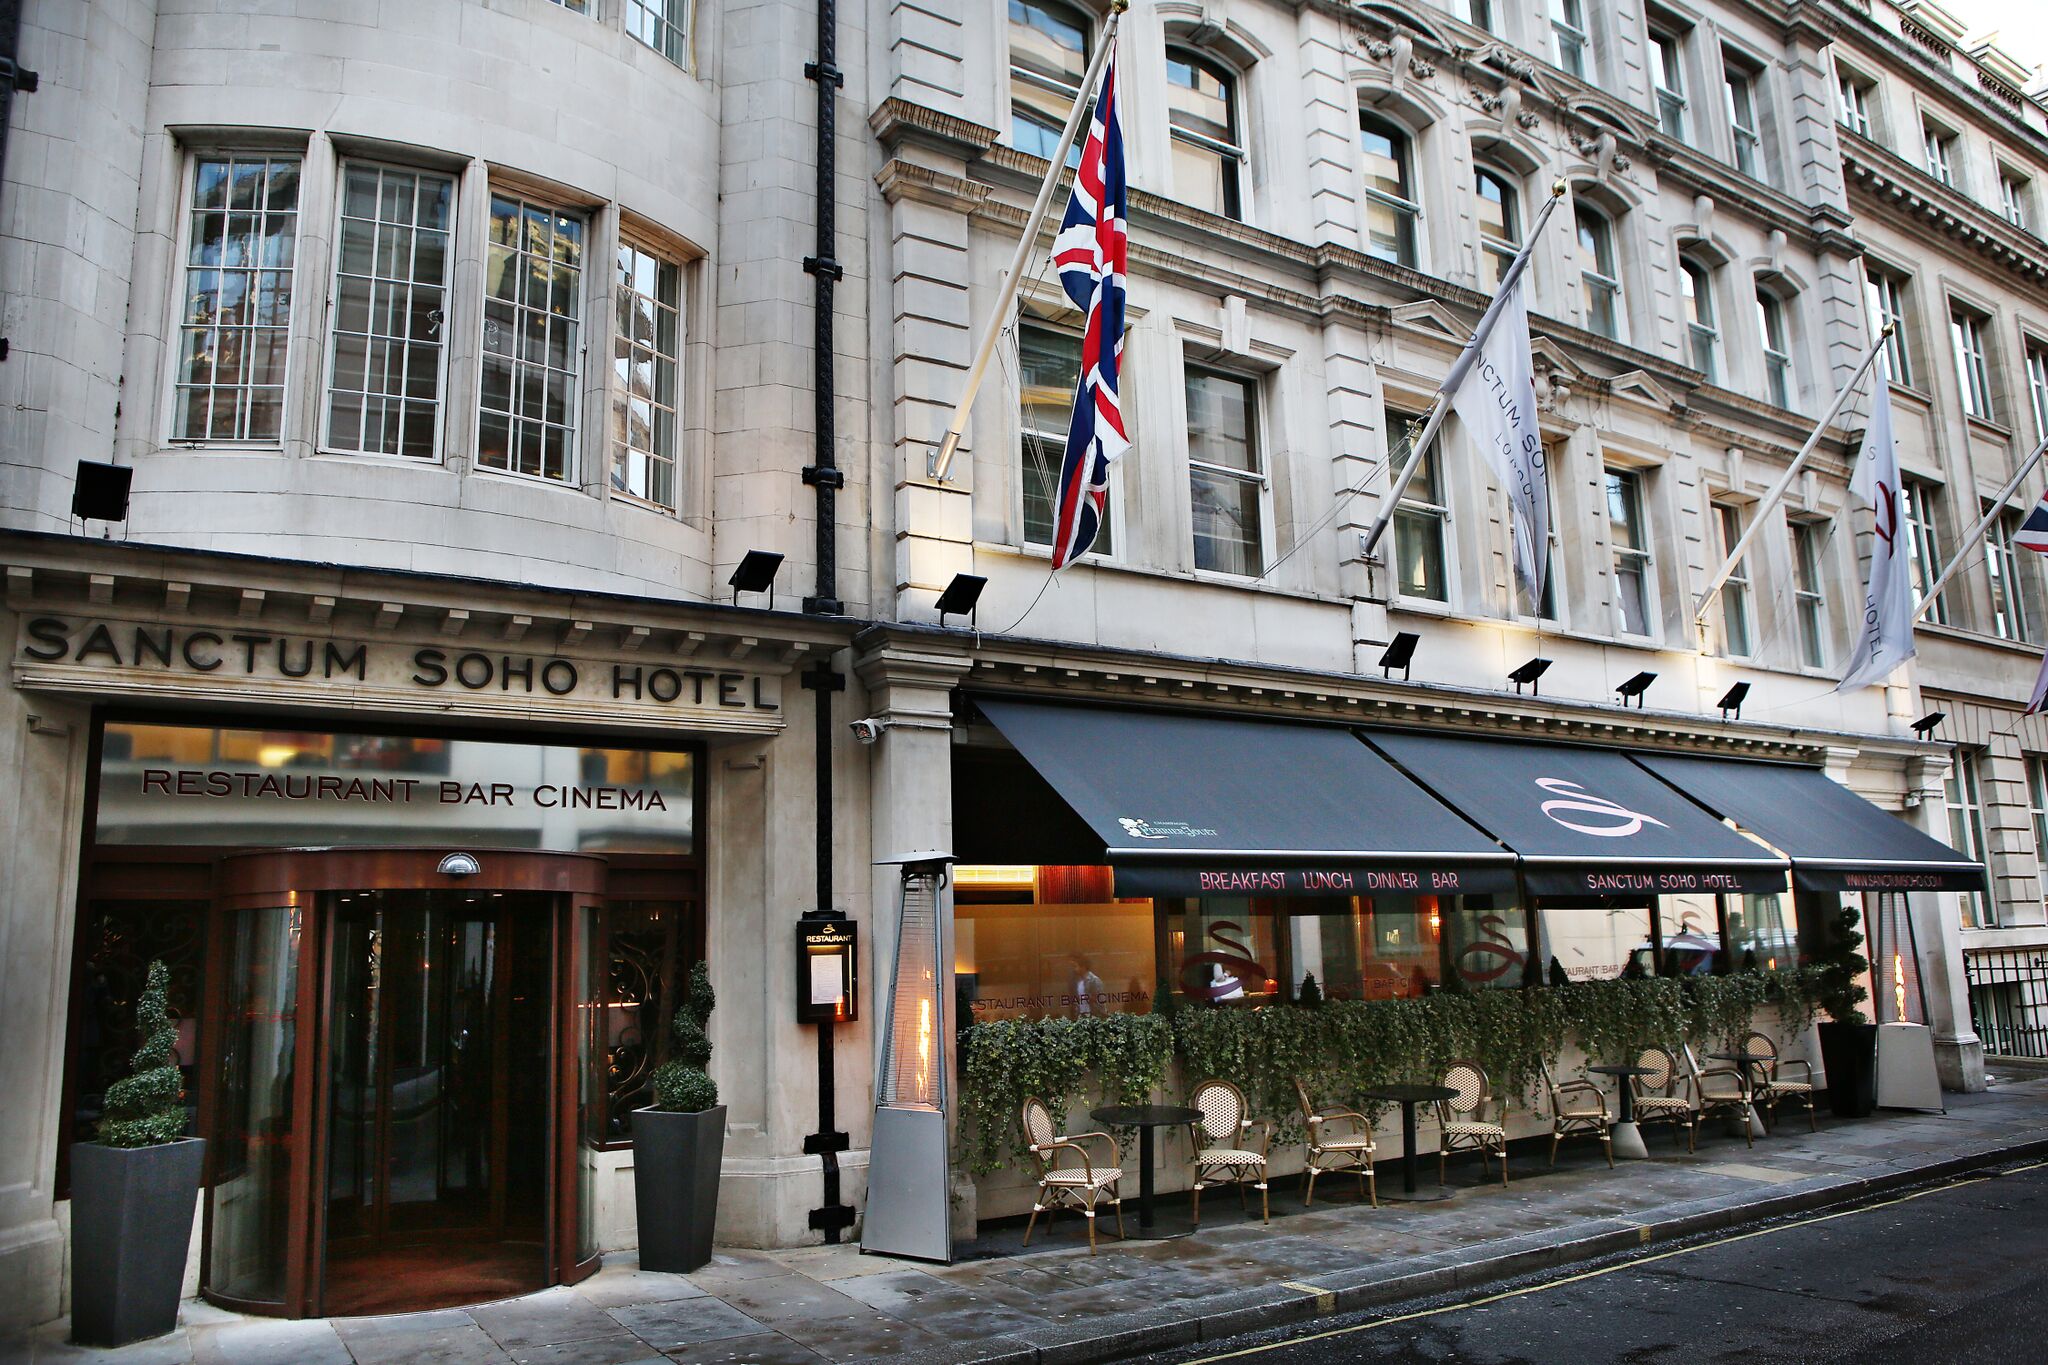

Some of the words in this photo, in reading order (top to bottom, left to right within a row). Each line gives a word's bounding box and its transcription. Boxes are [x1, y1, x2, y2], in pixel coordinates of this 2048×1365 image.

[1865, 594, 1883, 664] HOTEL
[24, 618, 367, 681] SANCTUM
[412, 649, 578, 696] SOHO
[613, 664, 779, 710] HOTEL
[142, 769, 420, 802] RESTAURANT
[439, 781, 514, 806] BAR
[533, 785, 667, 811] CINEMA
[1200, 872, 1286, 890] BREAKFAST
[1303, 872, 1353, 889] LUNCH
[1368, 872, 1419, 889] DINNER
[1432, 872, 1459, 888] BAR
[1587, 874, 1654, 889] SANCTUM
[1659, 874, 1697, 889] SOHO
[1702, 875, 1742, 889] HOTEL
[806, 934, 852, 943] RESTAURANT
[1603, 965, 1619, 974] BAR
[1061, 994, 1089, 1008] BAR
[1097, 991, 1150, 1004] CINEMA
